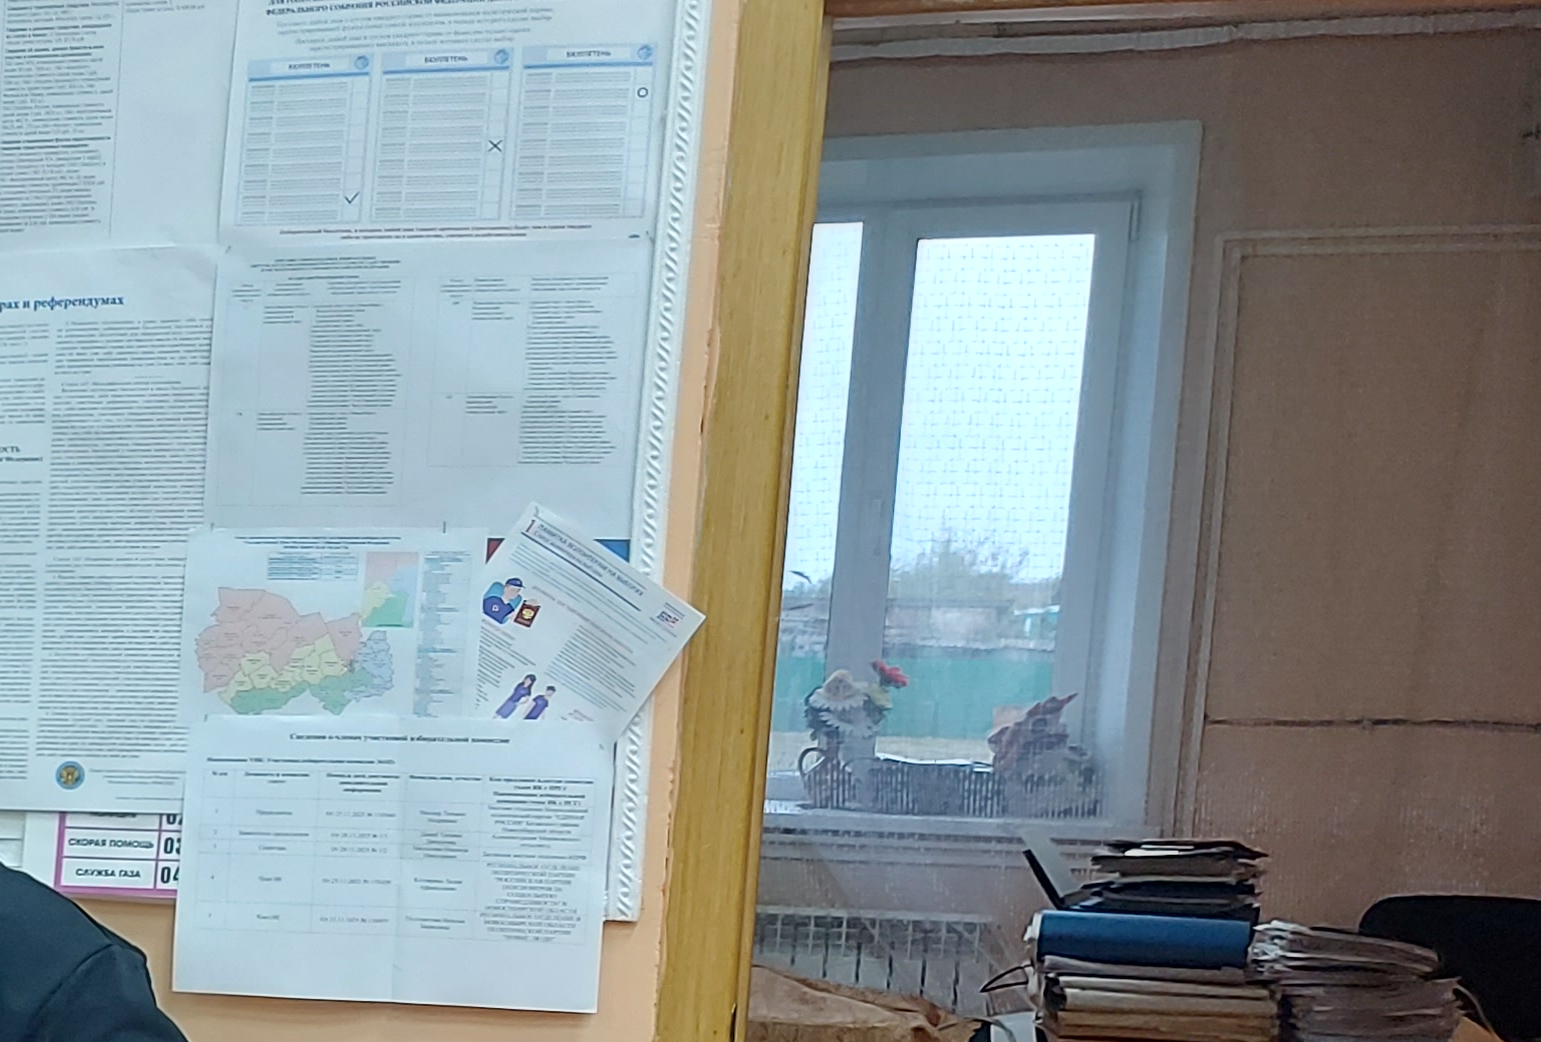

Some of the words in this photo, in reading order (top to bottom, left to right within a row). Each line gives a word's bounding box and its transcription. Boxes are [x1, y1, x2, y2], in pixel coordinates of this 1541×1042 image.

[33, 295, 125, 313] референдумах
[68, 838, 107, 848] СКОРАЯ
[109, 839, 155, 850] ПОМОЩЬ
[75, 867, 116, 878] СЛУЖБА
[118, 869, 142, 879] ГАЗА
